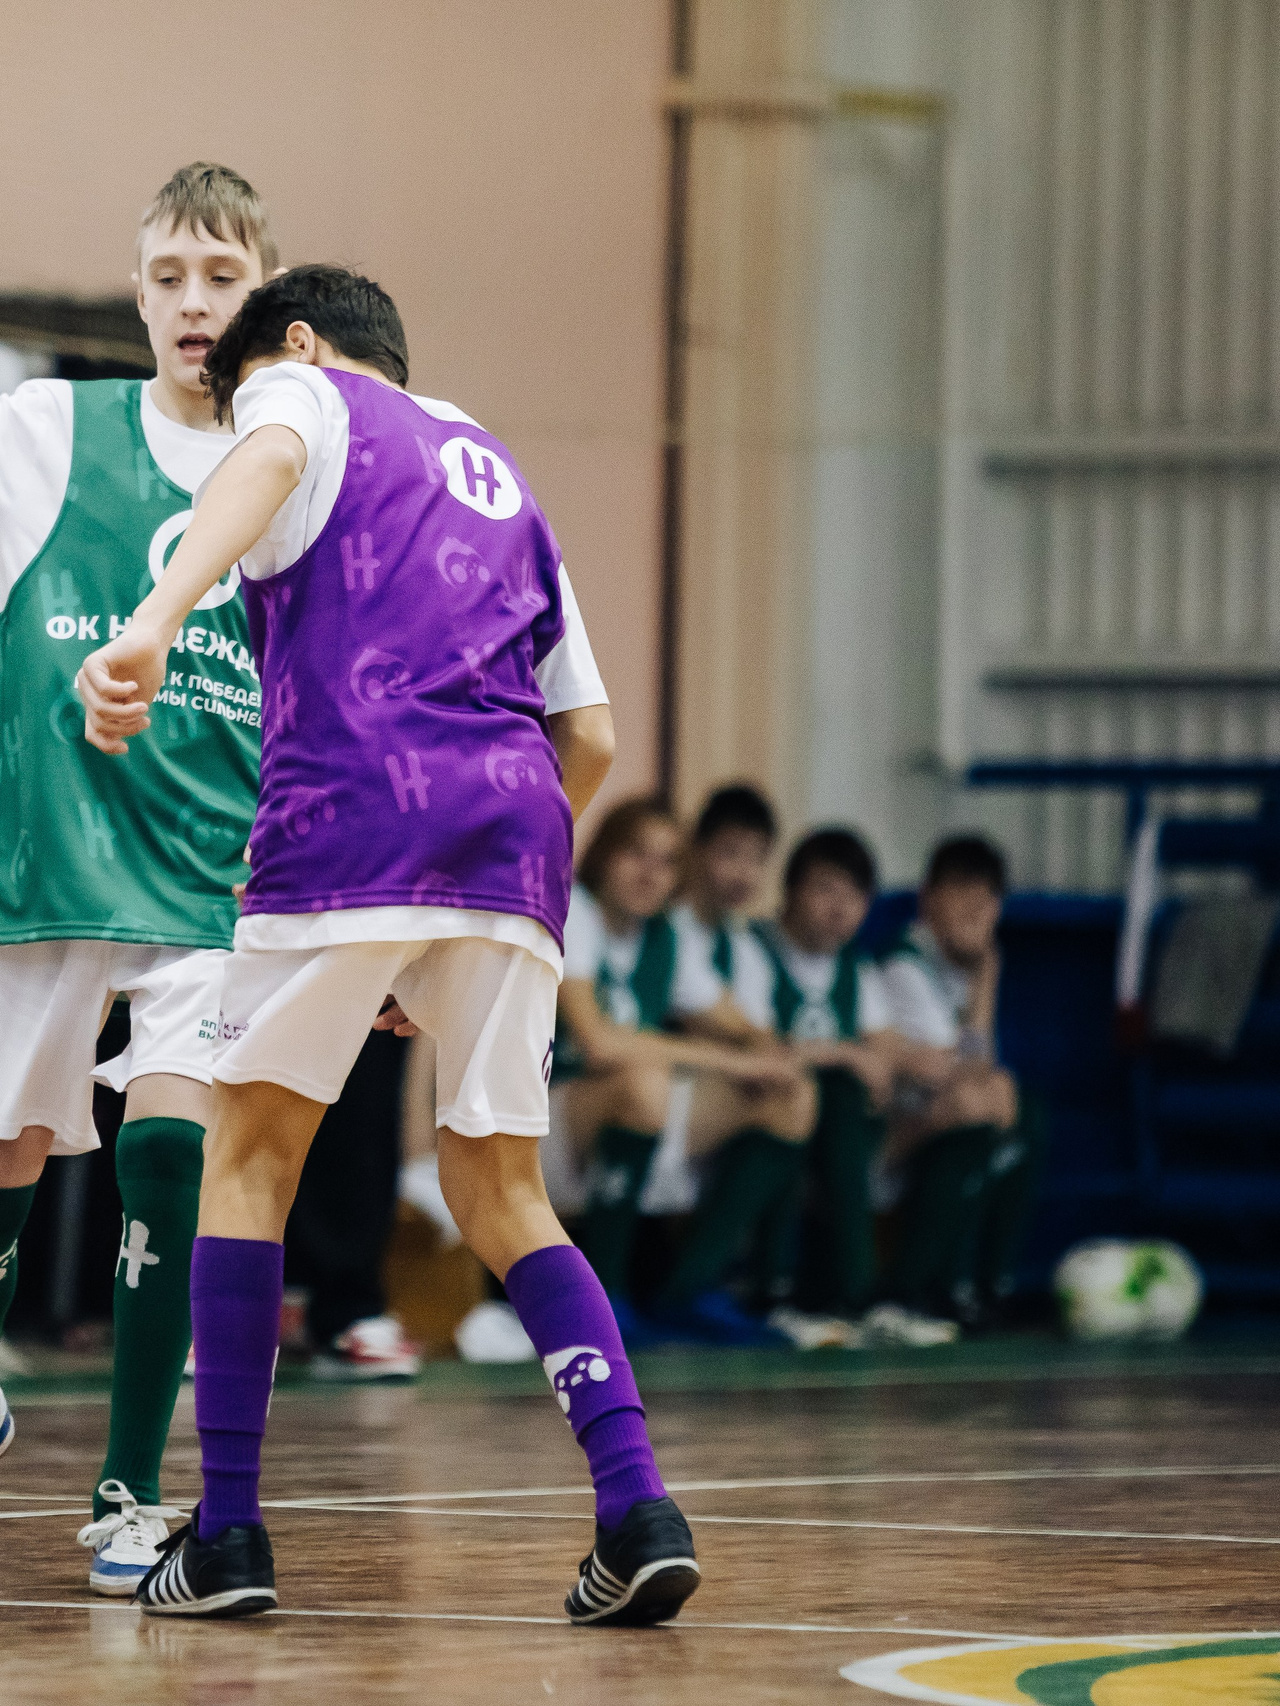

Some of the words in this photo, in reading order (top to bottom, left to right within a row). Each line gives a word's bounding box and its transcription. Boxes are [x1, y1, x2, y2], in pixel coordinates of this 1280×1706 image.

[45, 614, 100, 641] ФК
[170, 671, 185, 687] К
[152, 689, 187, 707] МЫ
